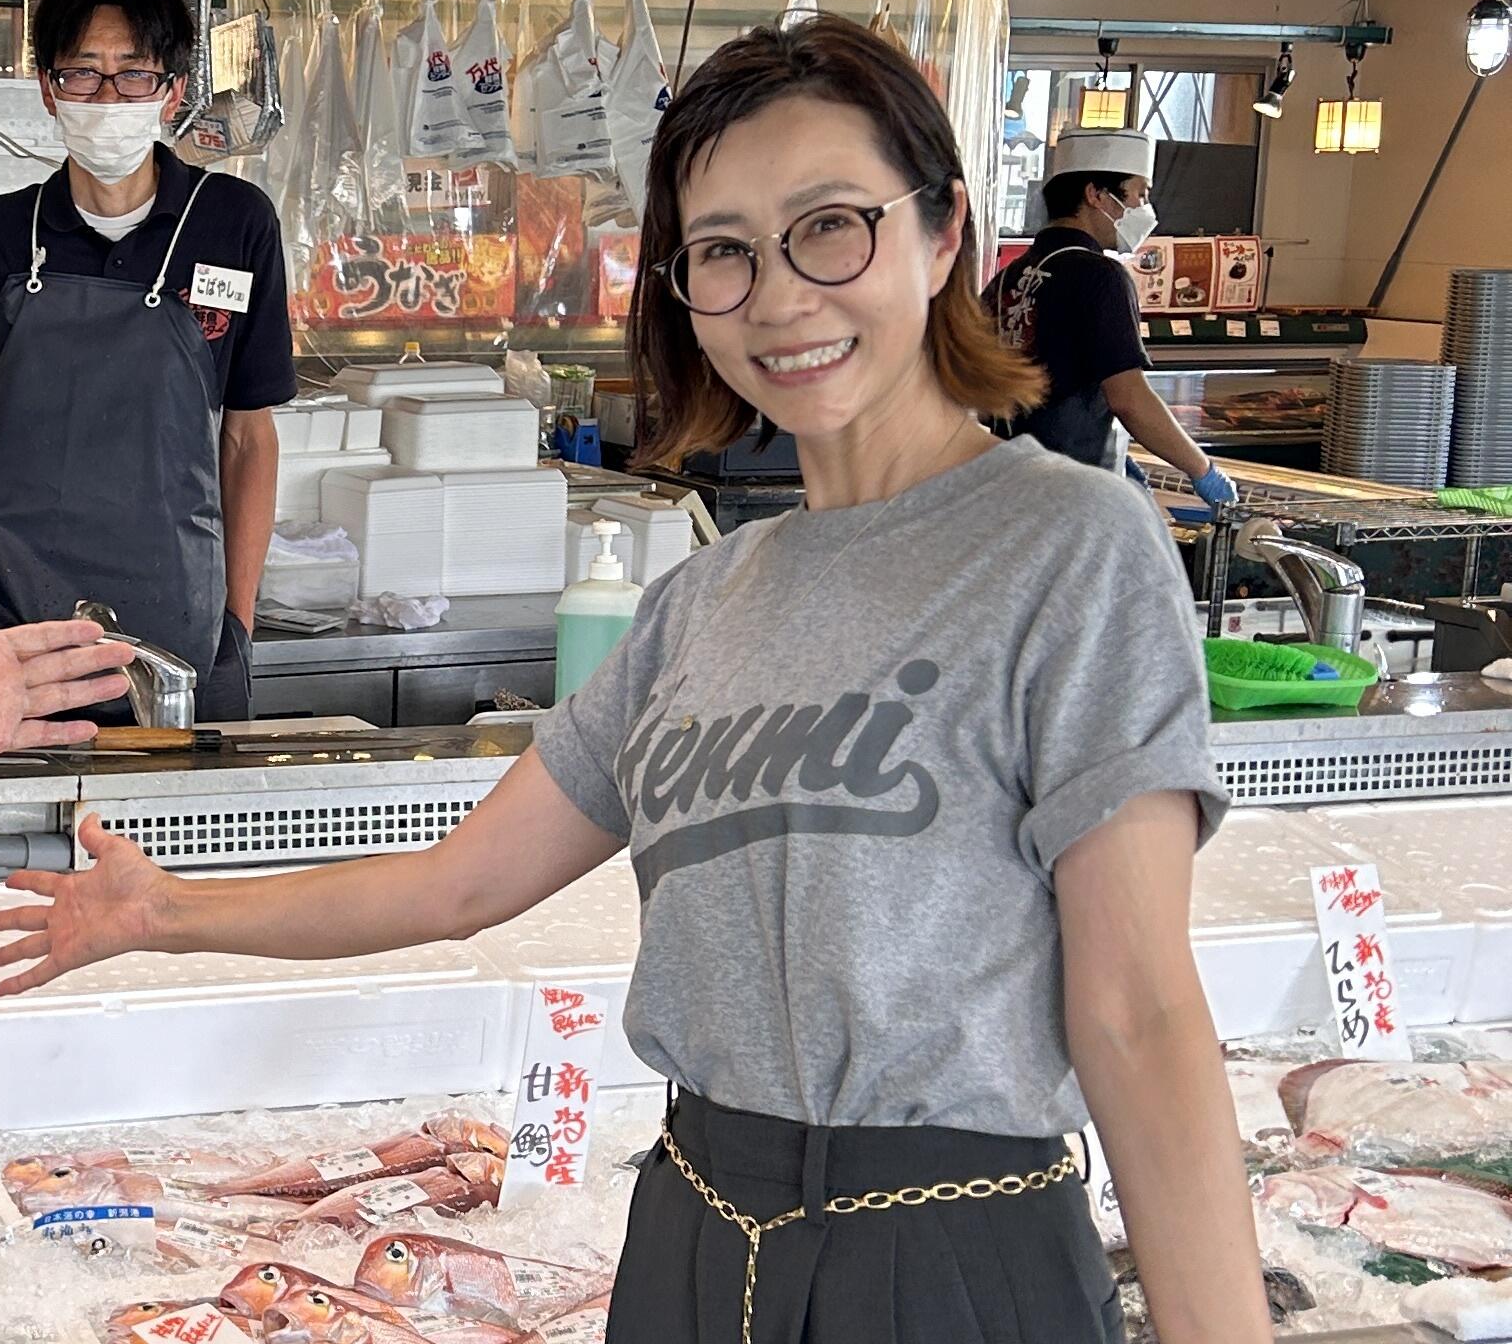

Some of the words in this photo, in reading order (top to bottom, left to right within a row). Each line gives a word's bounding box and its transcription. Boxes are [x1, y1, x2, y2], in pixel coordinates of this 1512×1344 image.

[197, 277, 235, 299] こばやし
[331, 234, 467, 318] うなぎ
[1325, 940, 1369, 1048] ひらめ
[510, 1062, 552, 1167] 甘鯛
[545, 1062, 594, 1185] 新潟産
